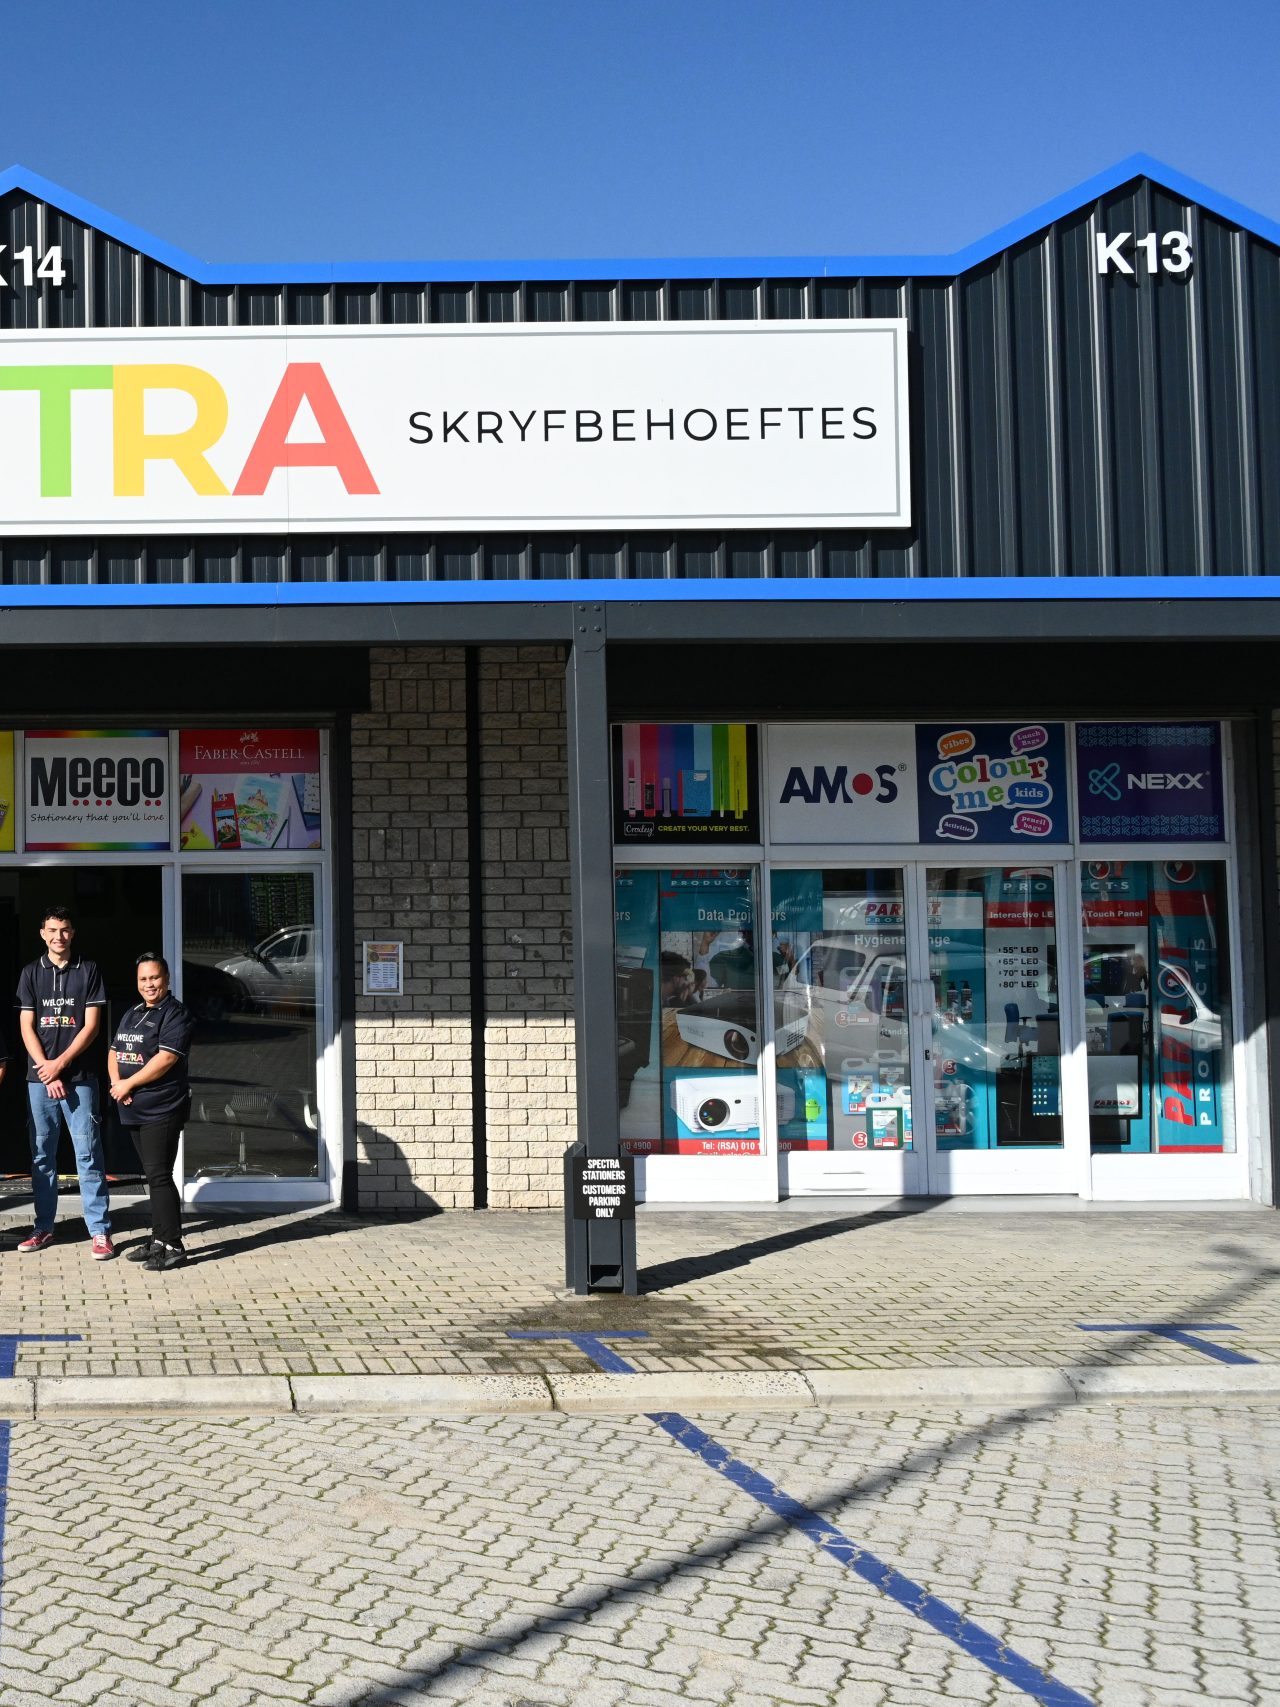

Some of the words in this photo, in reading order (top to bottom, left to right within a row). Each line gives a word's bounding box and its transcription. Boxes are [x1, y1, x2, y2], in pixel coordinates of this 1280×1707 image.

[1096, 230, 1192, 274] K13
[408, 406, 878, 445] SKRYFBEHOEFTES
[1017, 730, 1042, 741] Lunch
[942, 737, 970, 750] vibes
[932, 757, 1046, 793] Colour
[1127, 773, 1204, 790] NEXX
[955, 785, 1005, 810] me
[1015, 787, 1044, 798] kids
[30, 813, 83, 823] Stationery
[85, 812, 109, 821] that
[112, 812, 141, 824] you'll
[143, 813, 165, 821] love
[943, 821, 974, 833] Activities
[698, 908, 724, 921] Data
[990, 911, 1039, 919] Interactive
[1087, 910, 1115, 918] Touch
[854, 934, 906, 948] Hygiene
[1020, 969, 1039, 977] LED
[42, 998, 75, 1007] WELCOME
[53, 1007, 62, 1015] TO
[117, 1033, 144, 1043] WELCOME
[125, 1043, 133, 1051] TO
[116, 1051, 144, 1062] SPECTRA
[946, 1061, 953, 1069] 5
[857, 1134, 864, 1143] 5
[702, 1141, 715, 1150] Tel:
[717, 1141, 739, 1151] (RSA)
[740, 1141, 755, 1150] 010
[587, 1158, 620, 1169] SPECTRA
[582, 1170, 626, 1181] STATIONERS
[582, 1184, 626, 1195] CUSTOMERS
[588, 1196, 621, 1207] PARKING
[595, 1207, 615, 1218] ONLY
